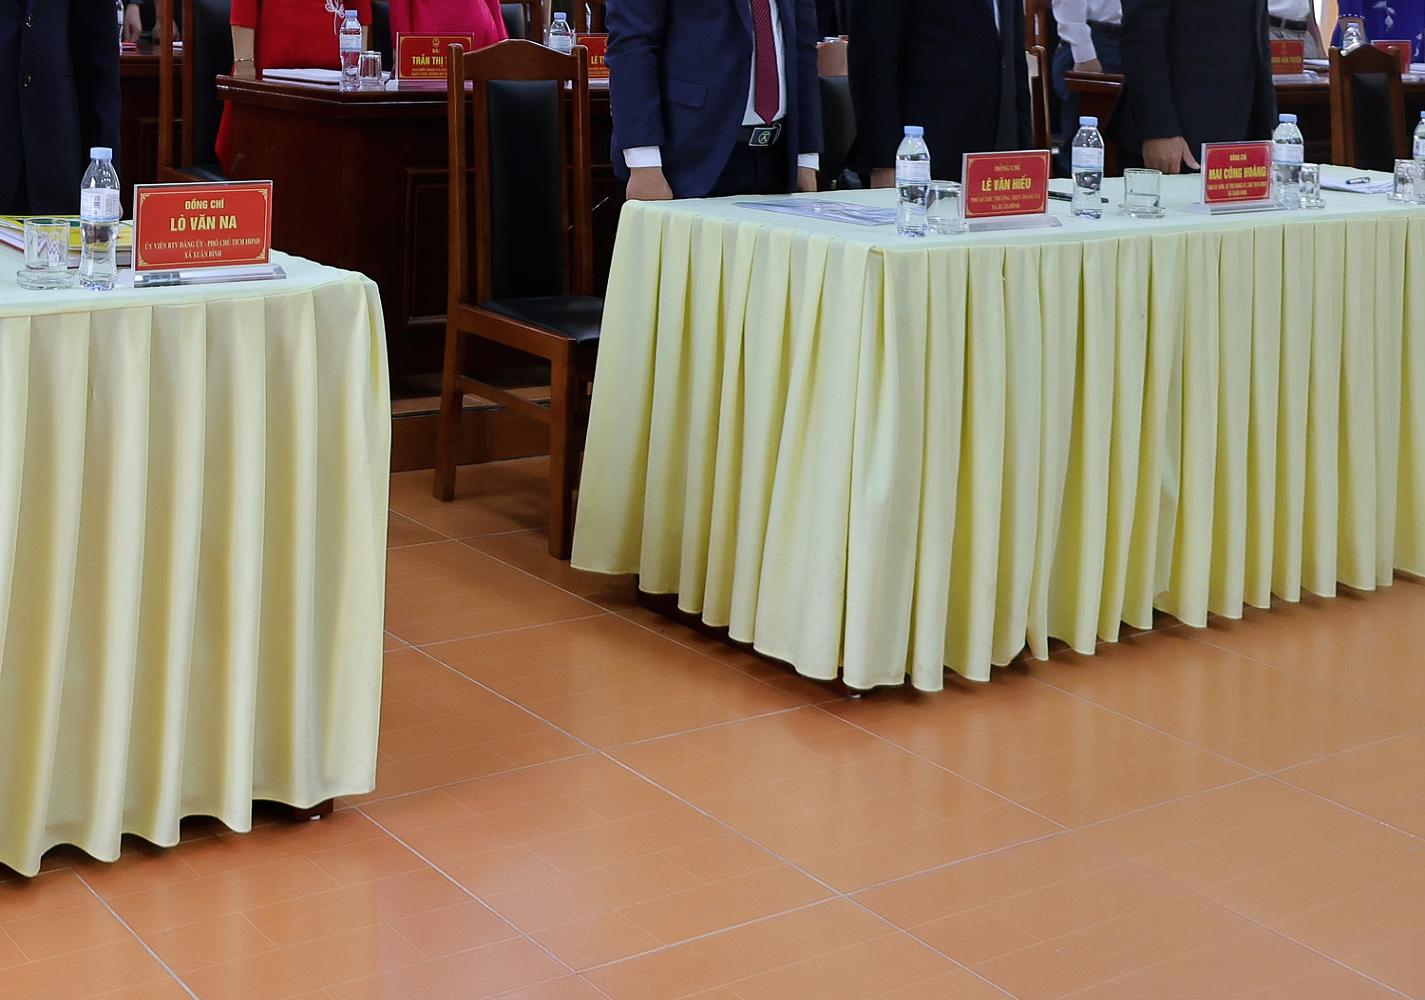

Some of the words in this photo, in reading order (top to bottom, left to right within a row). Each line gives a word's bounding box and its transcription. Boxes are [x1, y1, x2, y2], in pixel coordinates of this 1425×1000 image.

[432, 57, 443, 66] THỊ
[1209, 169, 1222, 179] MAI
[1224, 166, 1242, 179] CÔNG
[1244, 164, 1266, 177] HOÀNG
[982, 178, 992, 191] LÊ
[994, 177, 1010, 190] VĂN
[1012, 174, 1031, 189] HIẾU
[210, 198, 224, 209] CHÍ
[171, 214, 186, 231] LÒ
[190, 214, 215, 230] VĂN
[219, 215, 237, 229] NA
